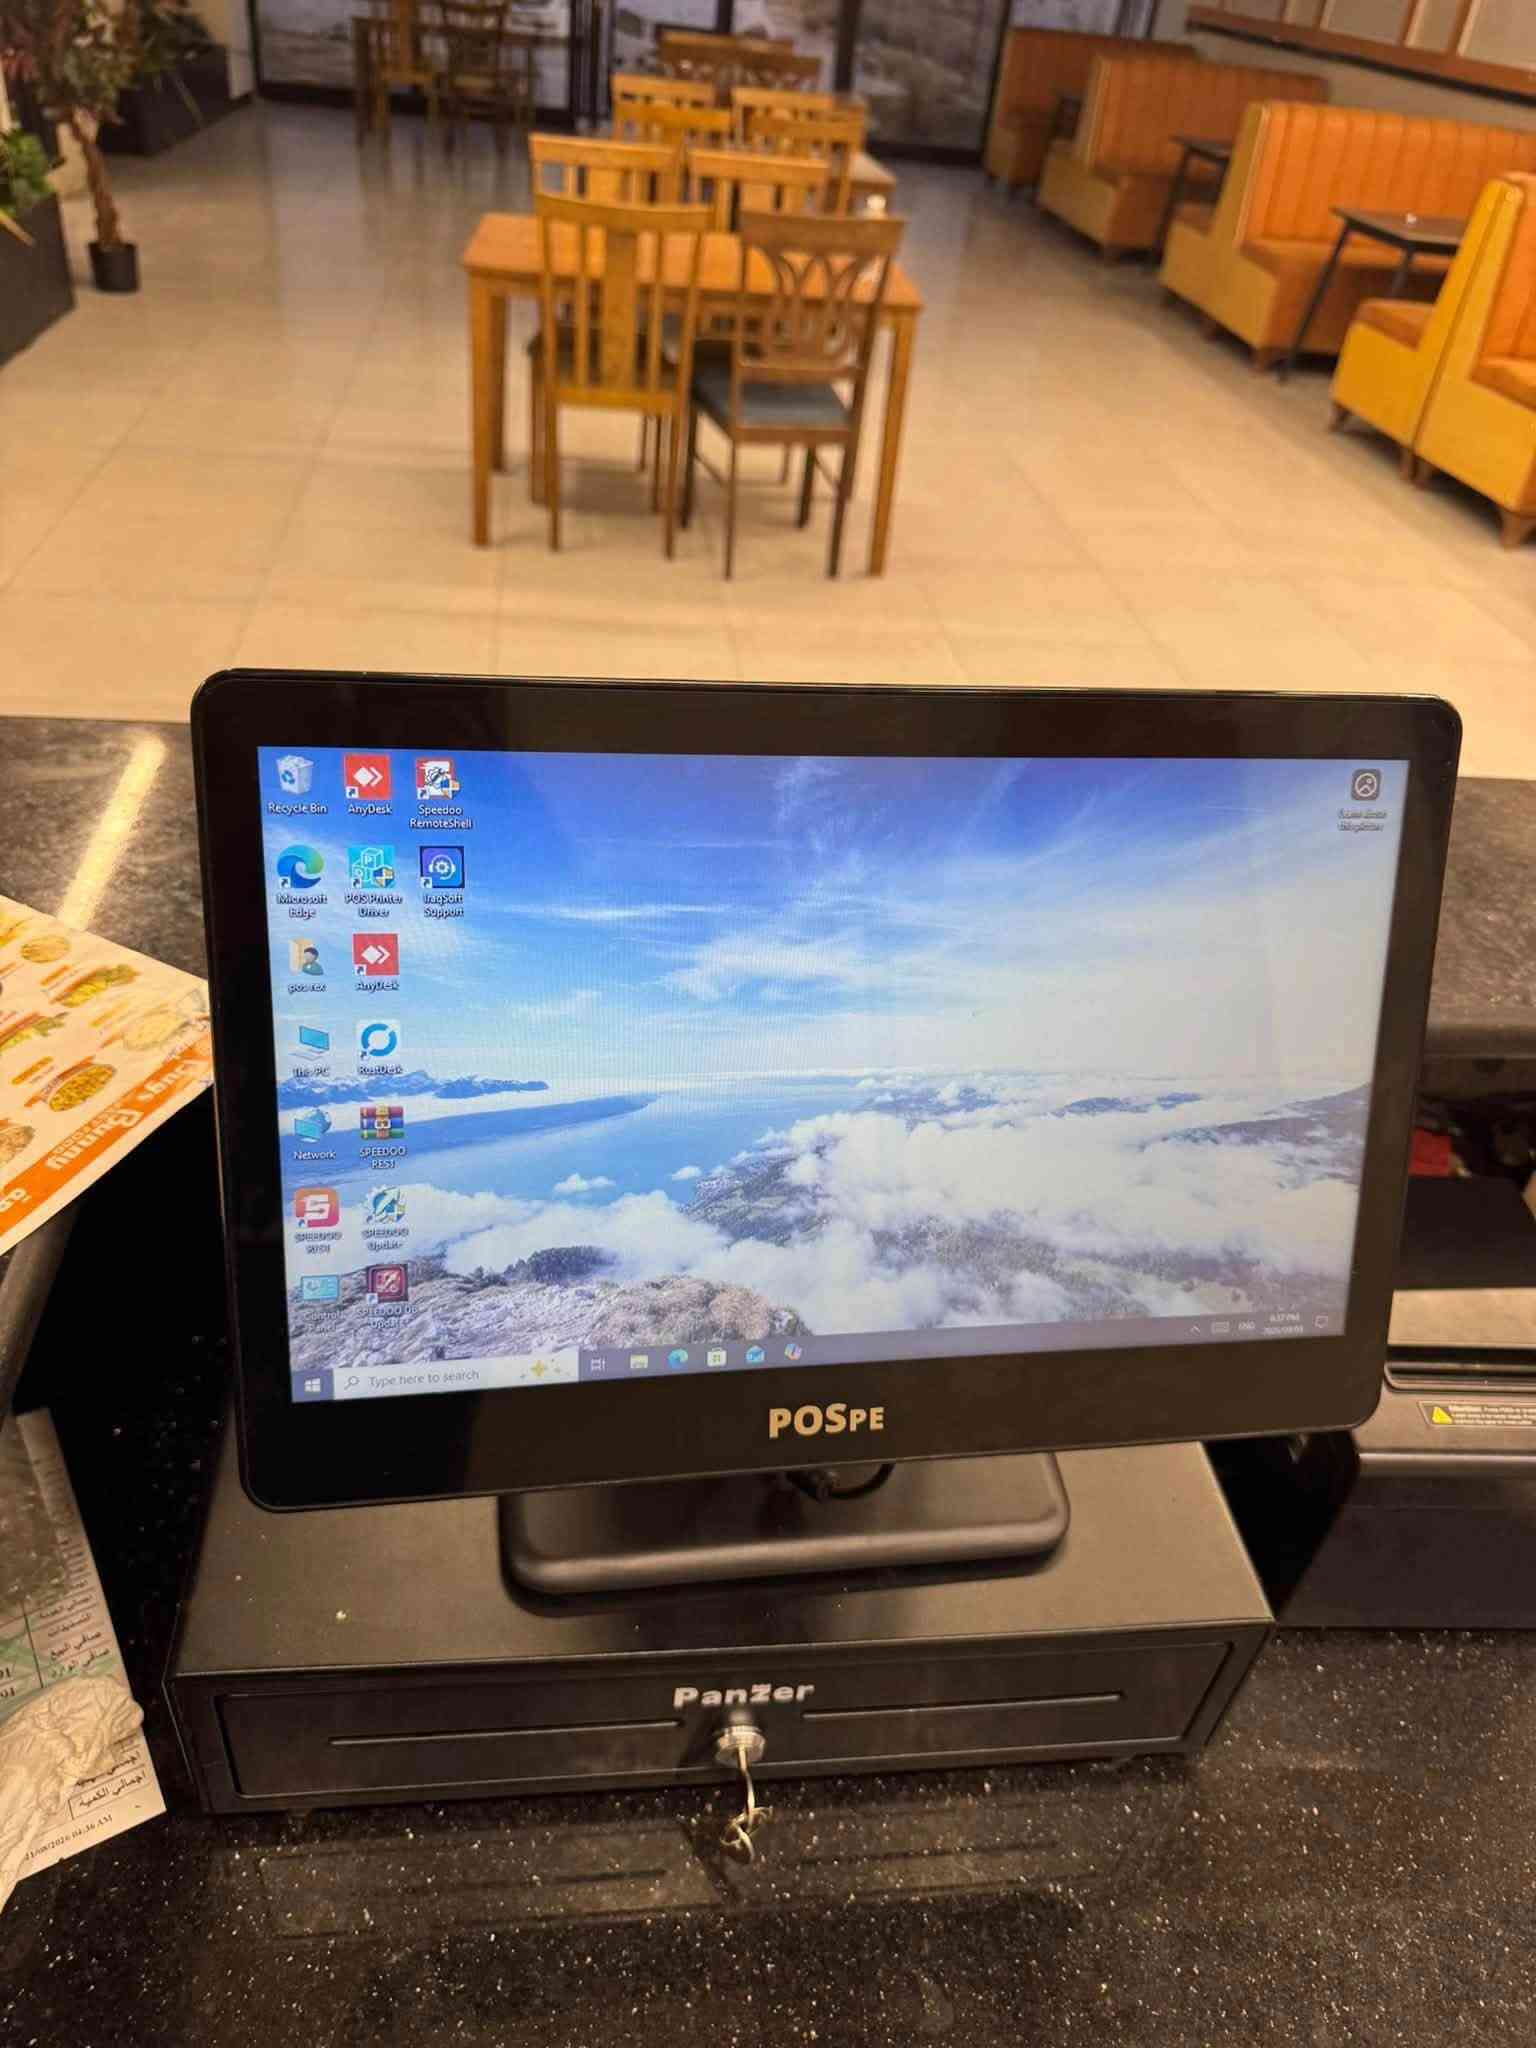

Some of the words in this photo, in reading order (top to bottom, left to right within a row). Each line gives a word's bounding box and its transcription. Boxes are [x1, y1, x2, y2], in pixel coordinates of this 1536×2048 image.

[268, 803, 308, 815] Recycle
[310, 803, 327, 813] Bin
[348, 804, 392, 816] AnyDesk
[418, 805, 462, 816] Speedoo
[410, 819, 472, 829] RemoteShell
[277, 894, 328, 904] Microsoft
[345, 894, 367, 904] POS
[369, 894, 403, 904] Printer
[289, 908, 316, 919] Edge
[358, 908, 389, 917] Driver
[424, 908, 464, 919] Support
[356, 981, 400, 993] AnyDesk
[44, 1107, 143, 1171] Bunny
[294, 1151, 336, 1160] Network
[360, 1147, 406, 1158] SPEEDOO
[368, 1376, 396, 1389] Type
[400, 1374, 425, 1385] here
[428, 1373, 440, 1383] to
[443, 1370, 480, 1382] search
